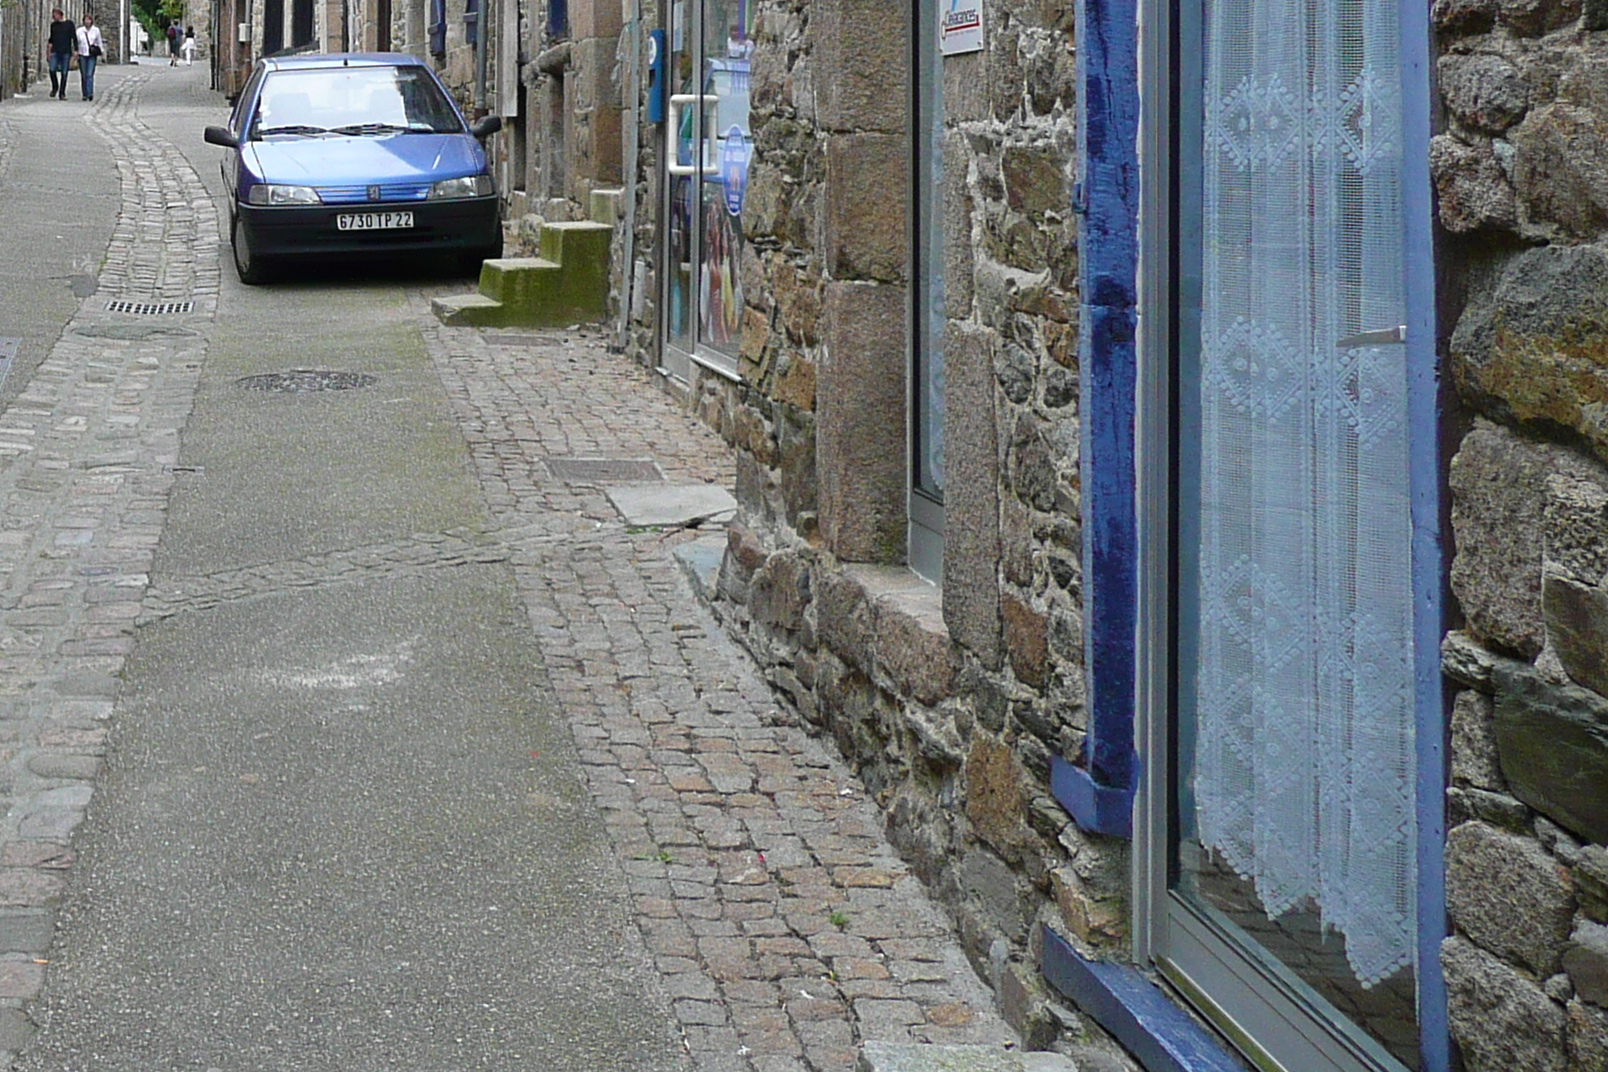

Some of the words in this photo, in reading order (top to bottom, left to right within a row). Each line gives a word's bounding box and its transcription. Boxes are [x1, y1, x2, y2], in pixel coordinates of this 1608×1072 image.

[340, 214, 373, 229] 6730
[376, 213, 392, 228] TP
[395, 212, 411, 227] 22
